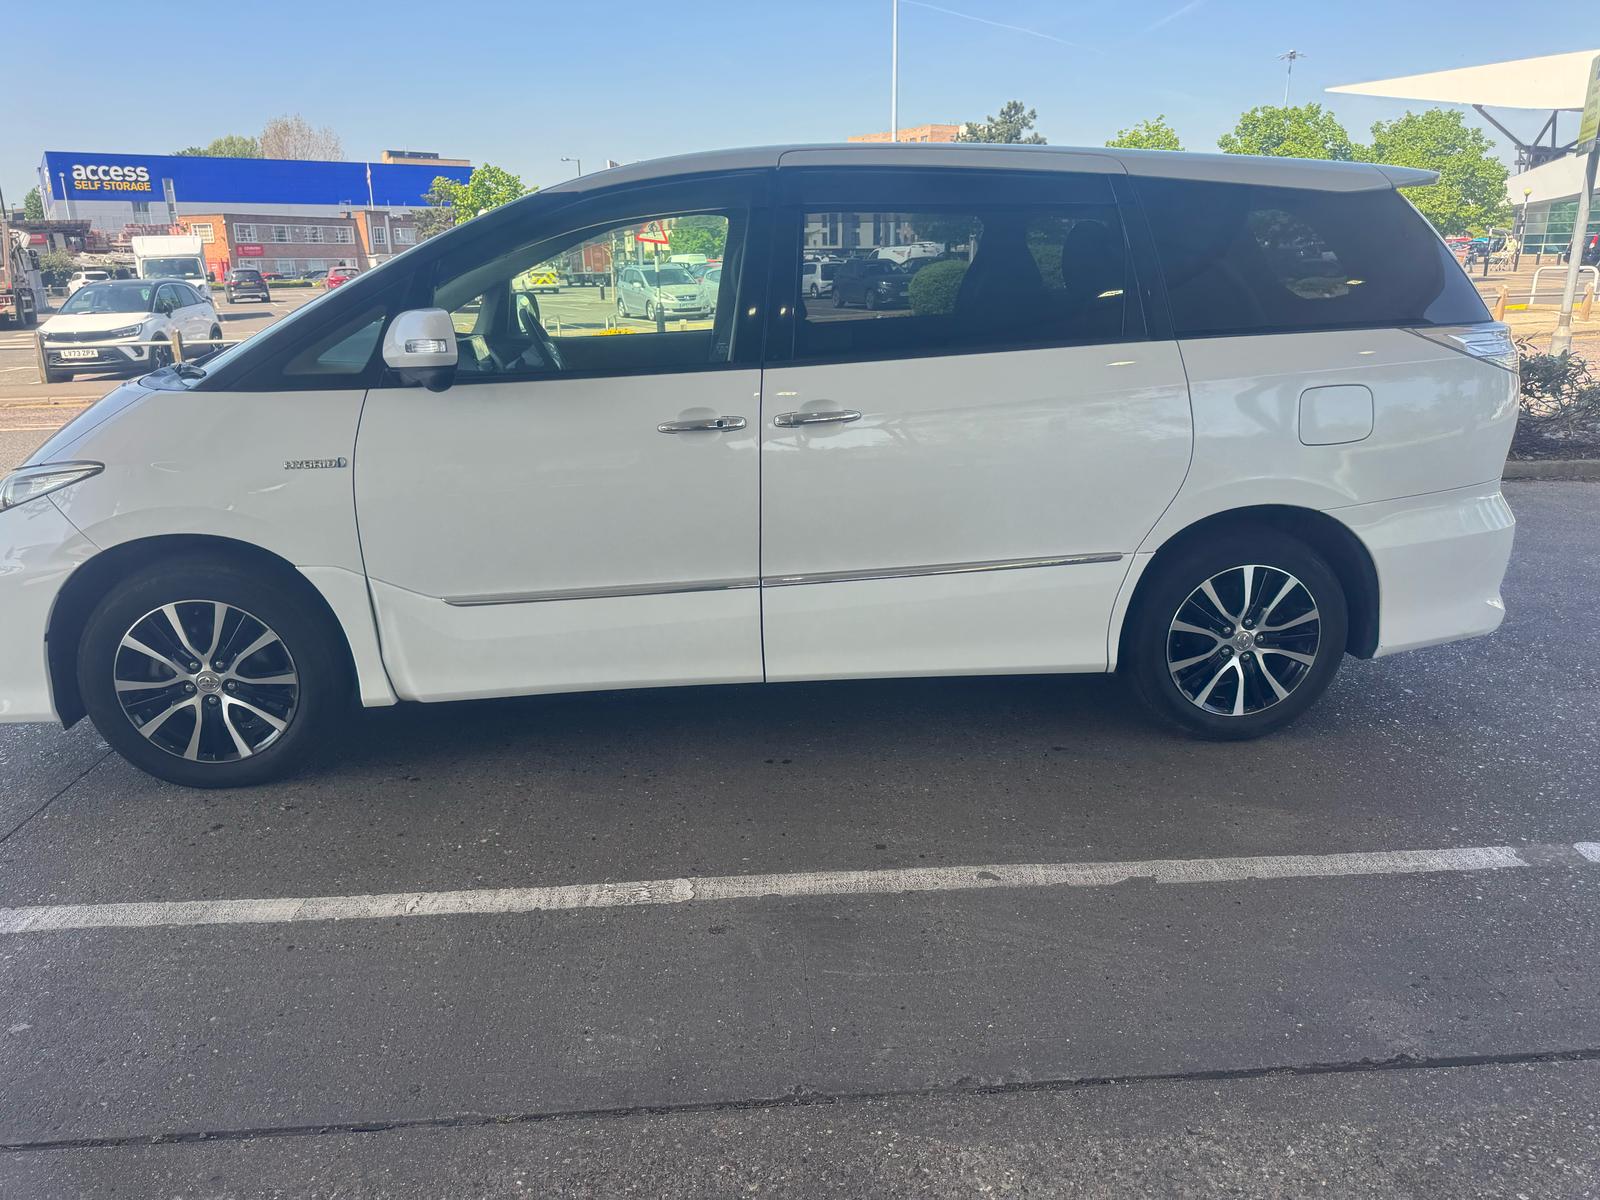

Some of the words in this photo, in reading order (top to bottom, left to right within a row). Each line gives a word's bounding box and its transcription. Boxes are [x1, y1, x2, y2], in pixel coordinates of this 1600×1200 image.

[72, 164, 149, 181] access
[74, 181, 101, 190] SELF
[103, 181, 151, 191] STORAGE
[283, 459, 337, 470] HYBRID
